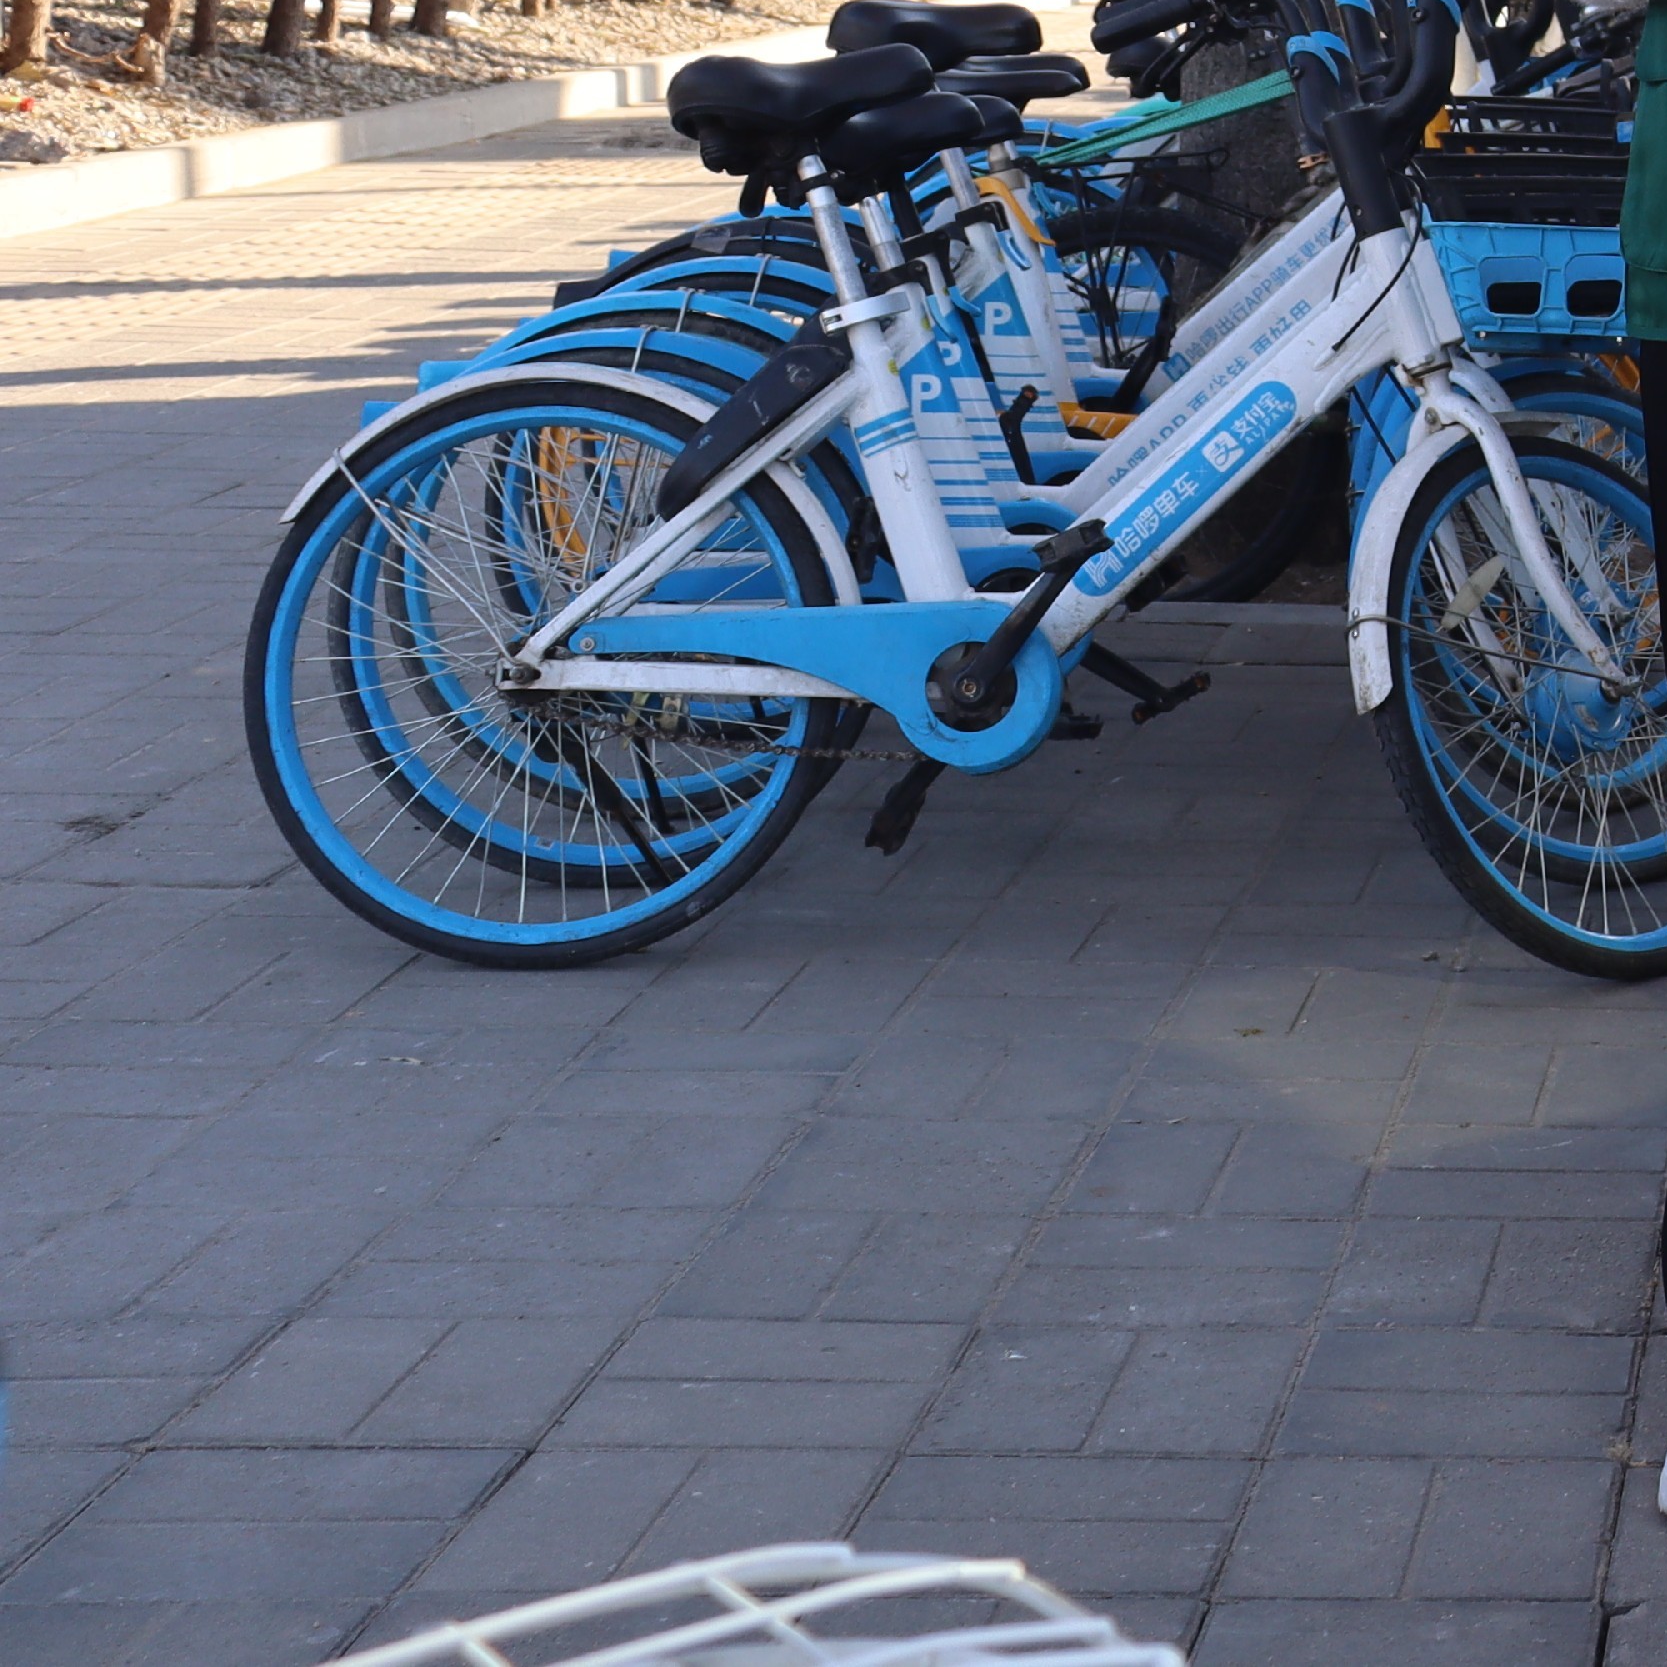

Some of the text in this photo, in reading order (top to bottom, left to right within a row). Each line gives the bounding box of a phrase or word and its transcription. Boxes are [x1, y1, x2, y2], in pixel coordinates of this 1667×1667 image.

[910, 373, 942, 413] P
[1113, 471, 1200, 559] 哈啰单车
